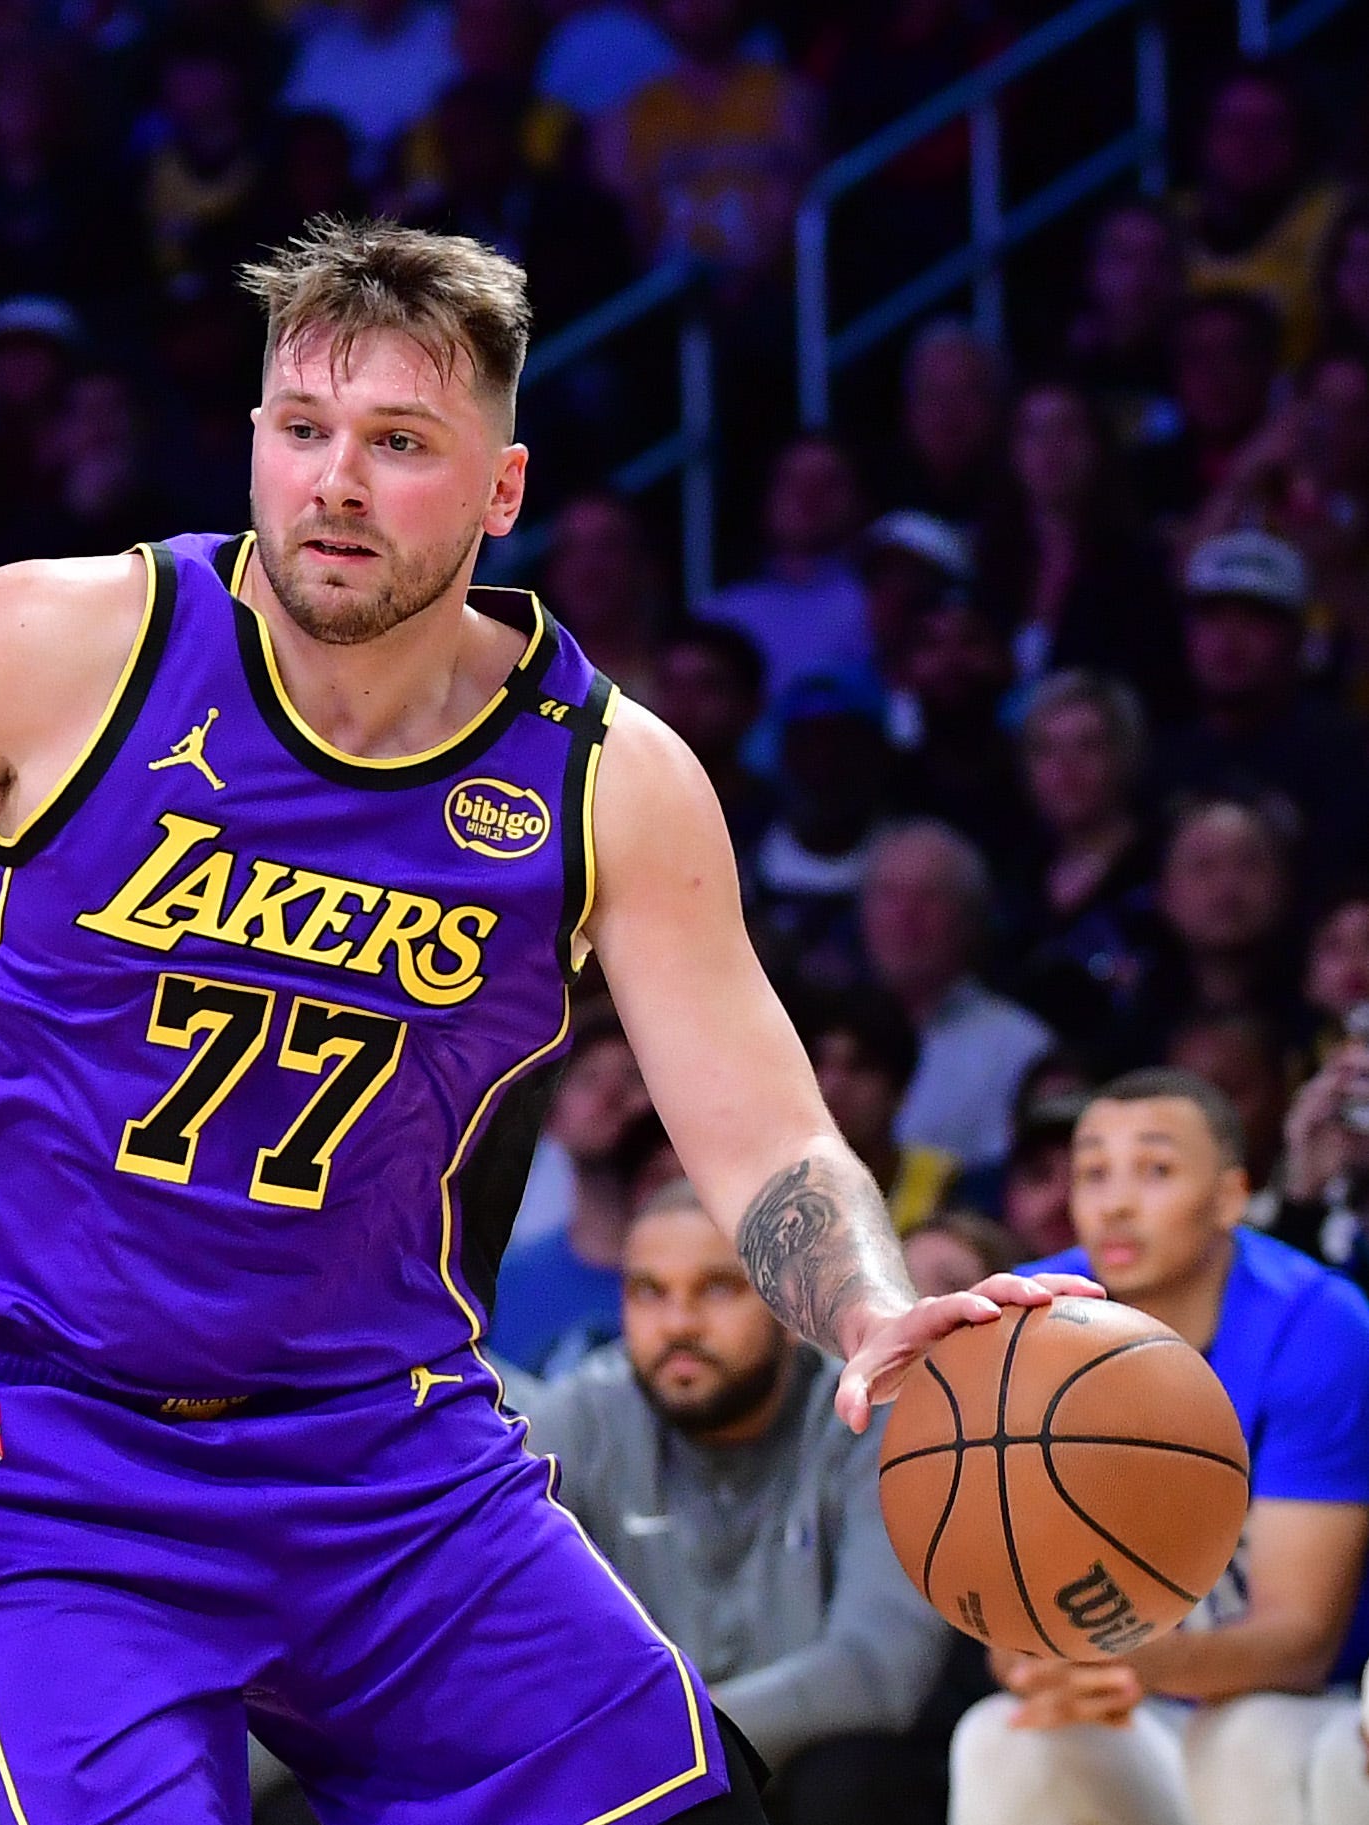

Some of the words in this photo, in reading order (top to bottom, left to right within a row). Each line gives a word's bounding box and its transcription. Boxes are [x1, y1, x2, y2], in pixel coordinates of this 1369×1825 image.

[539, 699, 570, 723] 44
[455, 791, 544, 840] bibigo
[466, 819, 504, 842] 비비고
[75, 811, 500, 1006] LAKERS
[114, 972, 408, 1211] 77
